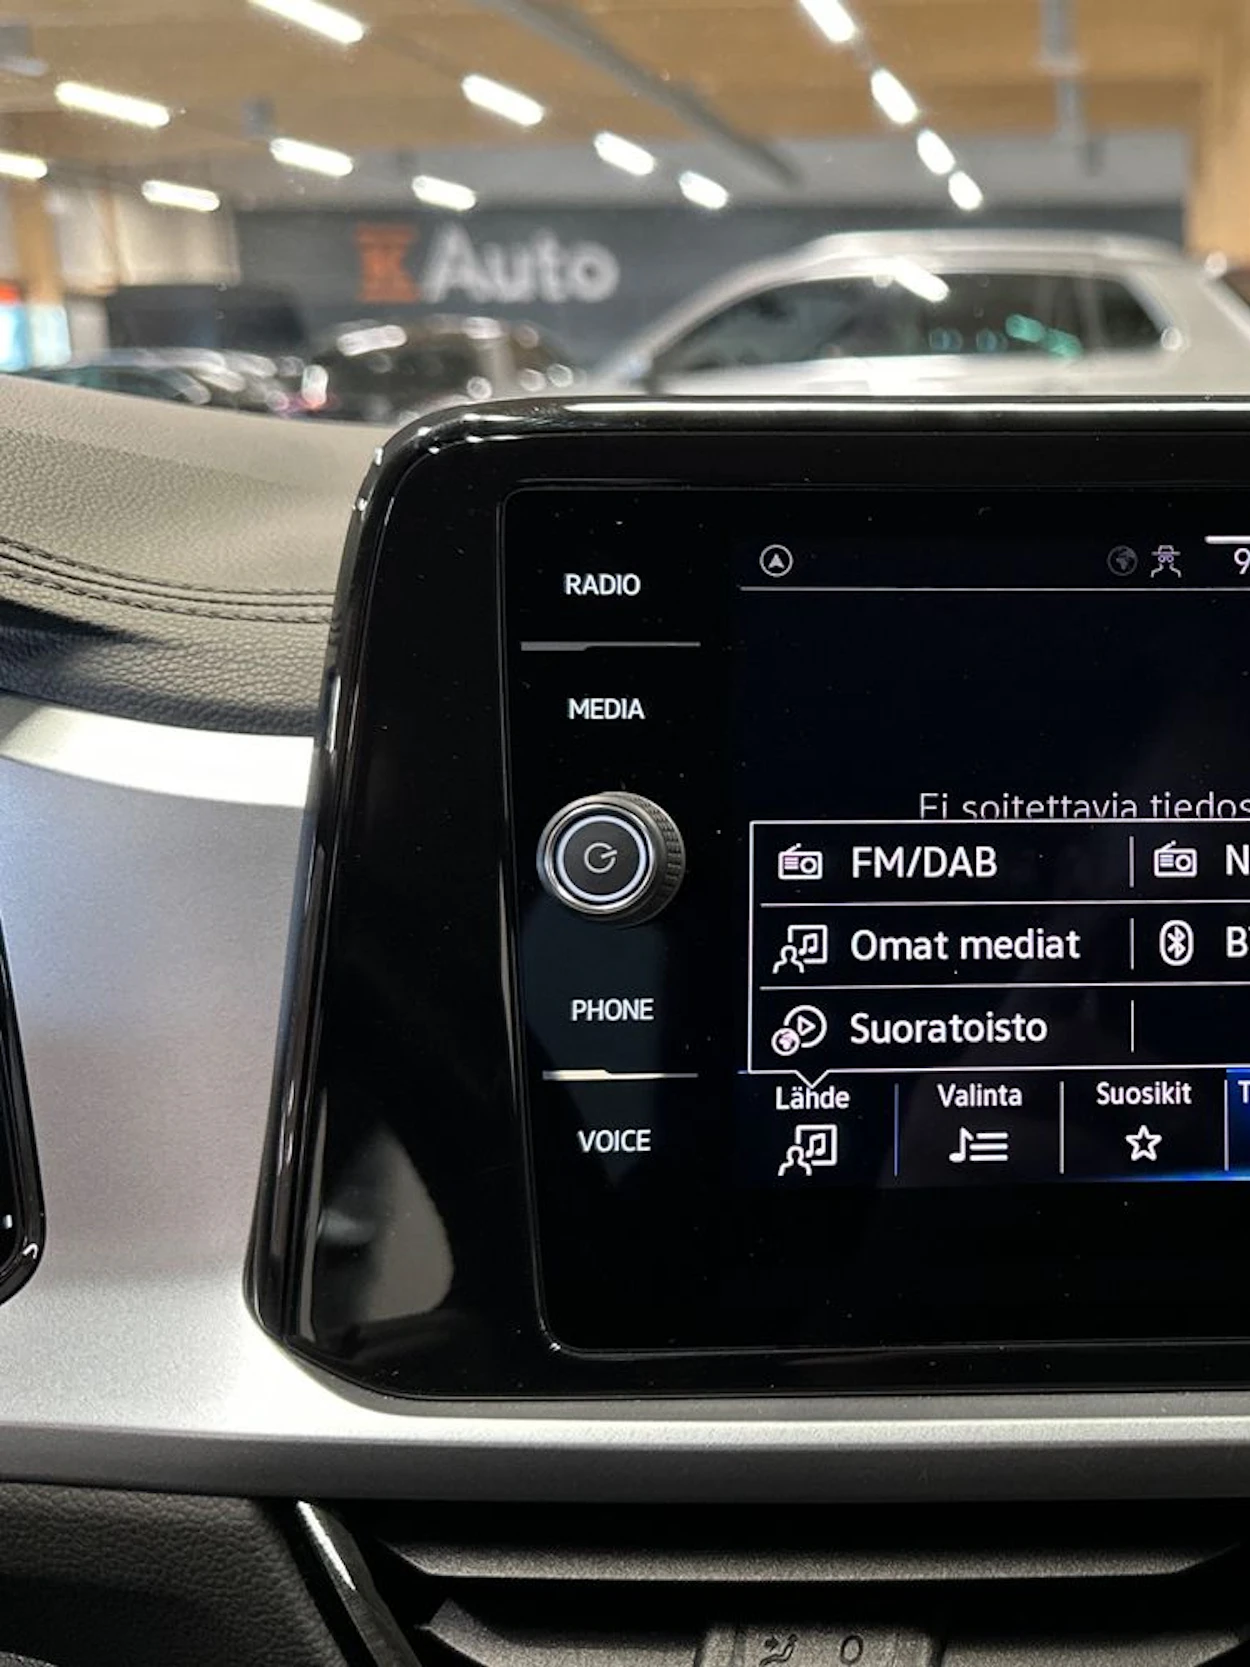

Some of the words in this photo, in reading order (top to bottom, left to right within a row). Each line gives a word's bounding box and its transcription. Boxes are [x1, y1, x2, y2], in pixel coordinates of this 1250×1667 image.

[565, 573, 641, 596] RADIO
[568, 697, 646, 720] MEDIA
[853, 845, 998, 878] FM/DAB
[851, 929, 949, 961] Omat
[960, 928, 1081, 960] mediat
[571, 997, 654, 1022] PHONE
[850, 1011, 1048, 1044] Suoratoisto
[775, 1085, 851, 1110] Lähde
[937, 1083, 1023, 1108] Valinta
[1096, 1080, 1192, 1106] Suosikit
[577, 1129, 652, 1153] VOICE
